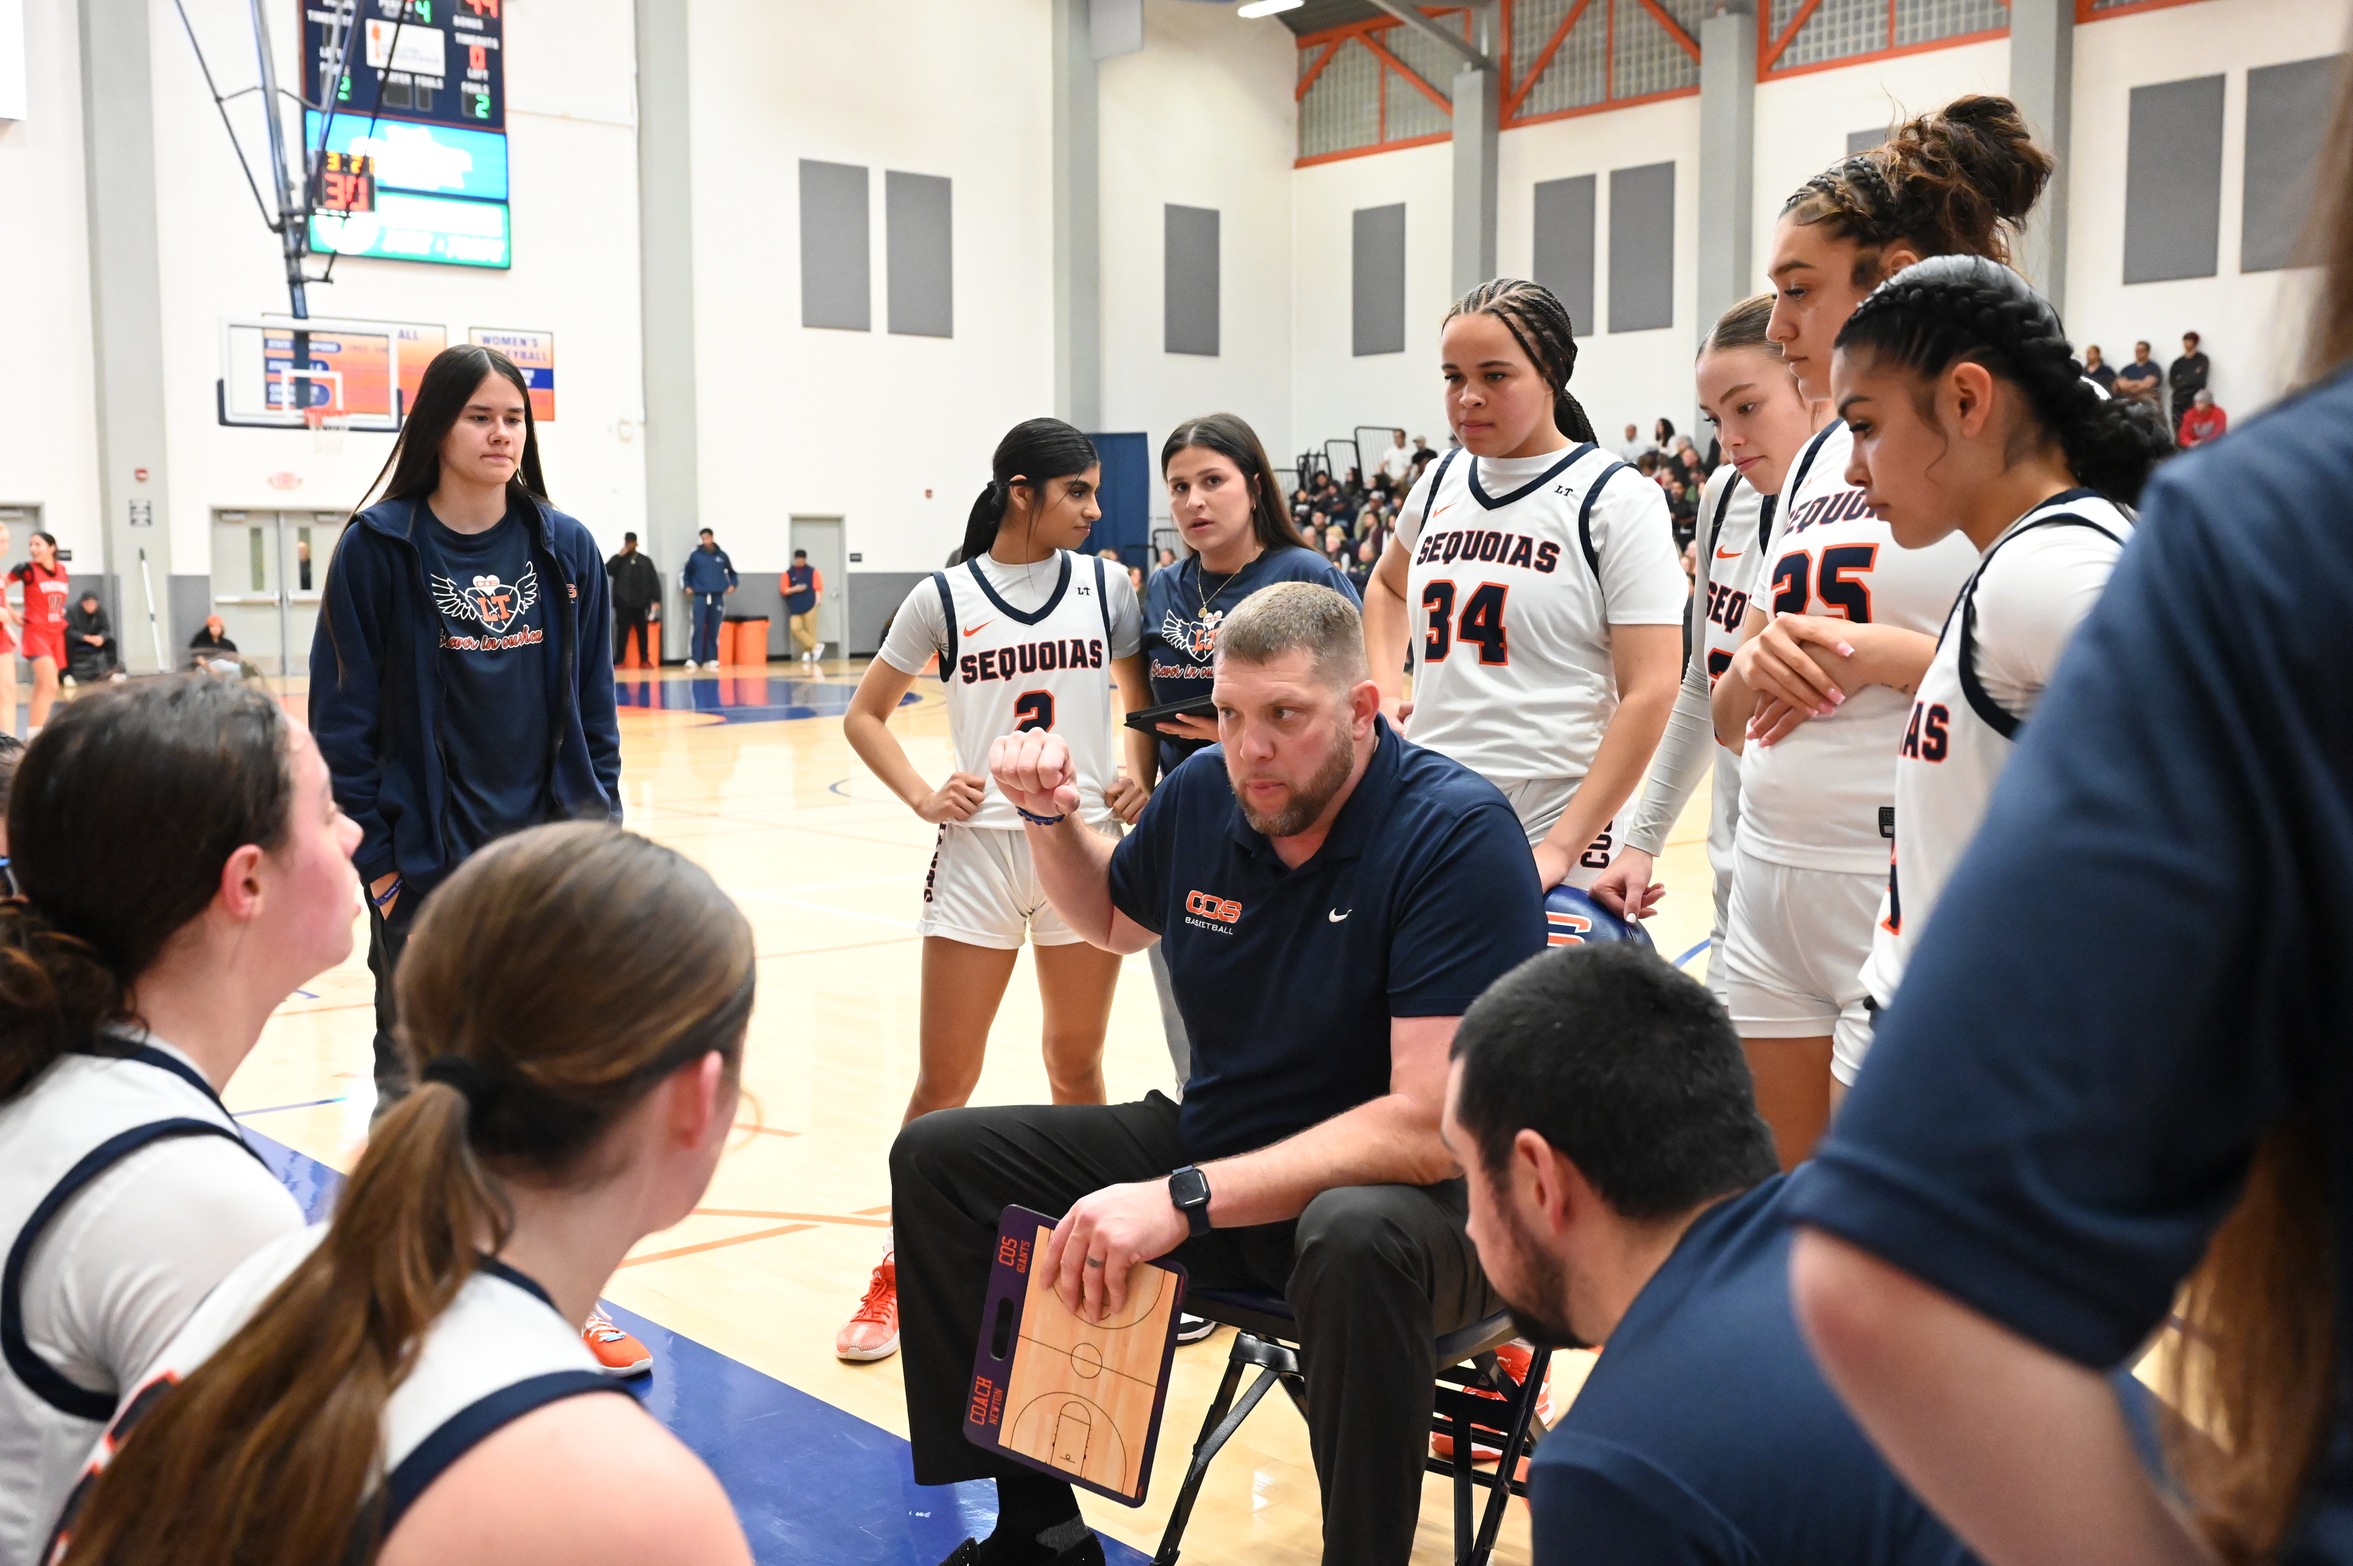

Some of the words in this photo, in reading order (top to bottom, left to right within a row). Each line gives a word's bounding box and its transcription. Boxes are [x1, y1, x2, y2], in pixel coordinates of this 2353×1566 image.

[469, 45, 486, 69] 0
[475, 94, 491, 119] 2
[1553, 485, 1574, 497] LT
[1416, 529, 1562, 574] SEQUOIAS
[1077, 586, 1091, 596] LT
[1770, 542, 1881, 624] 25
[477, 594, 511, 622] LT
[1422, 579, 1510, 667] 34
[960, 638, 1103, 685] SEQUOIAS
[1014, 689, 1055, 733] 2
[1185, 889, 1243, 924] COS
[998, 1235, 1018, 1268] COS
[1016, 1239, 1031, 1274] GIANTS
[969, 1375, 993, 1426] COACH
[988, 1387, 1003, 1426] NEWTON
